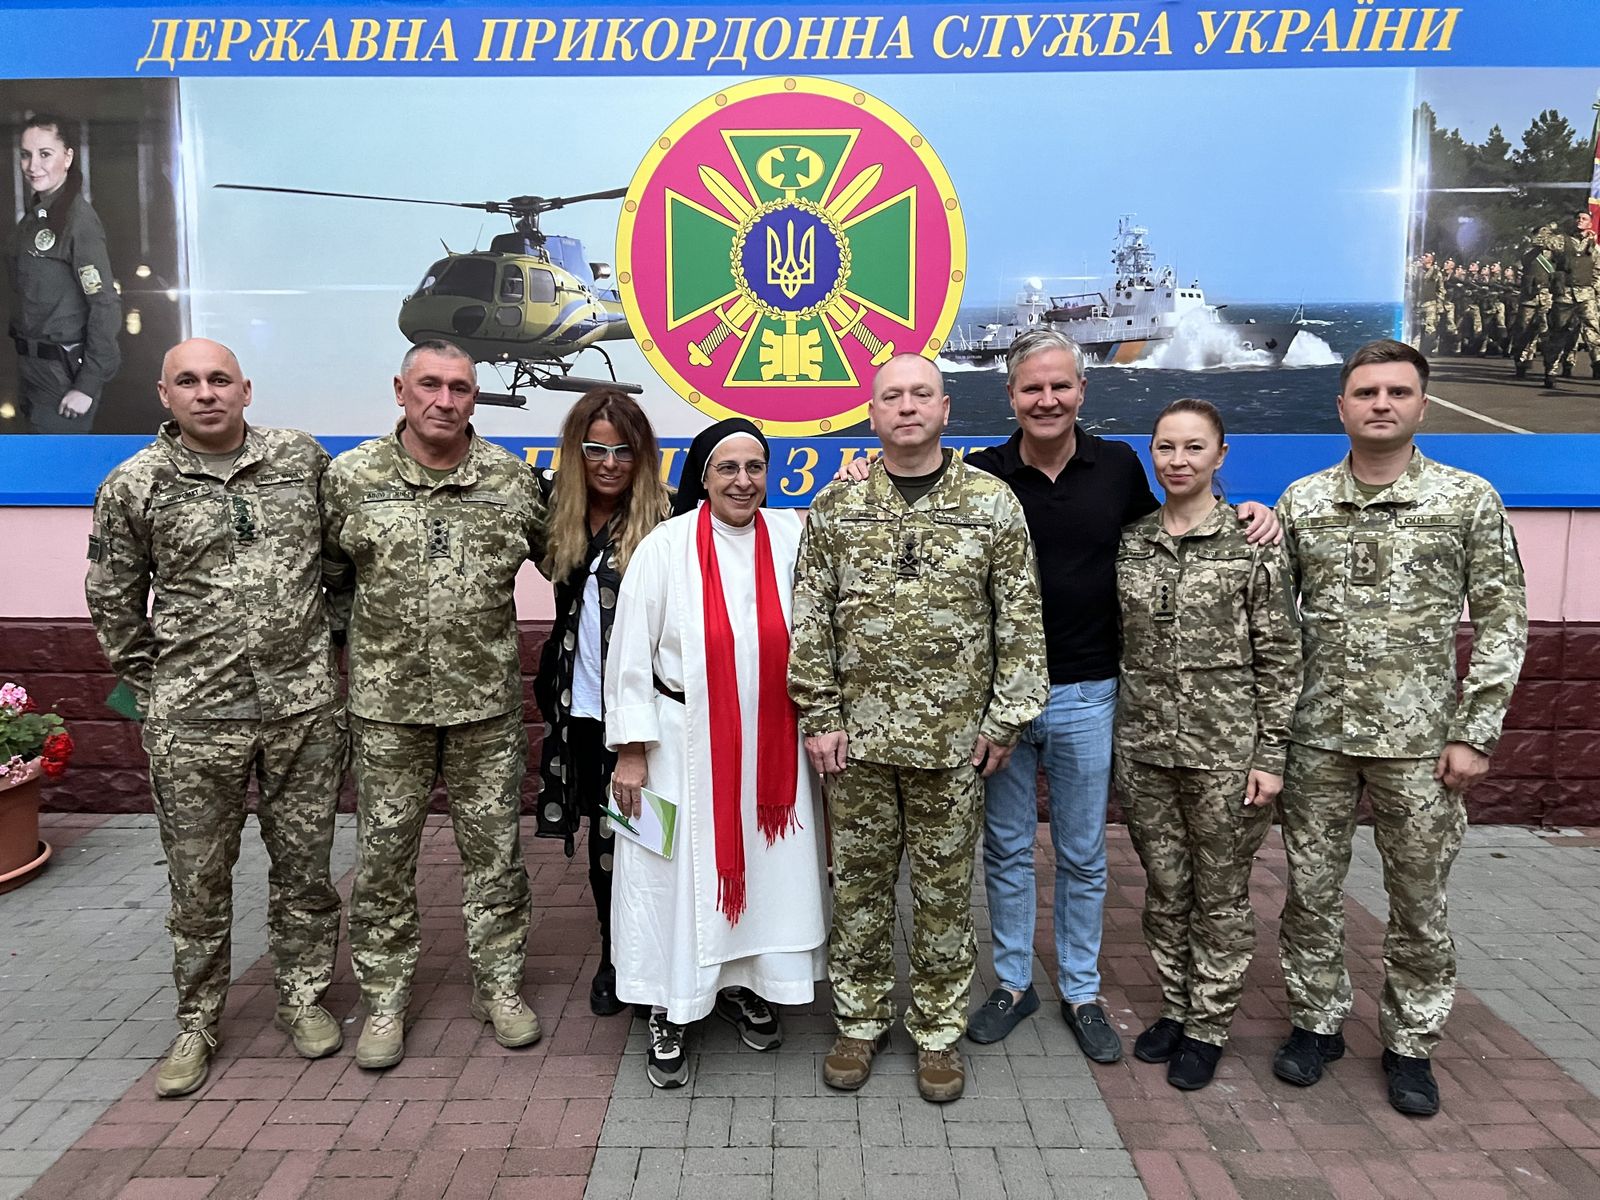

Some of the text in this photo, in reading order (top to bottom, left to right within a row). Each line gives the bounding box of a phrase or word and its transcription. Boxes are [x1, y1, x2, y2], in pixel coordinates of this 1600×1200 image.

[136, 0, 1463, 72] ДЕРЖАВНА ПРИКОРДОННА СЛУЖБА УКРАЇНИ
